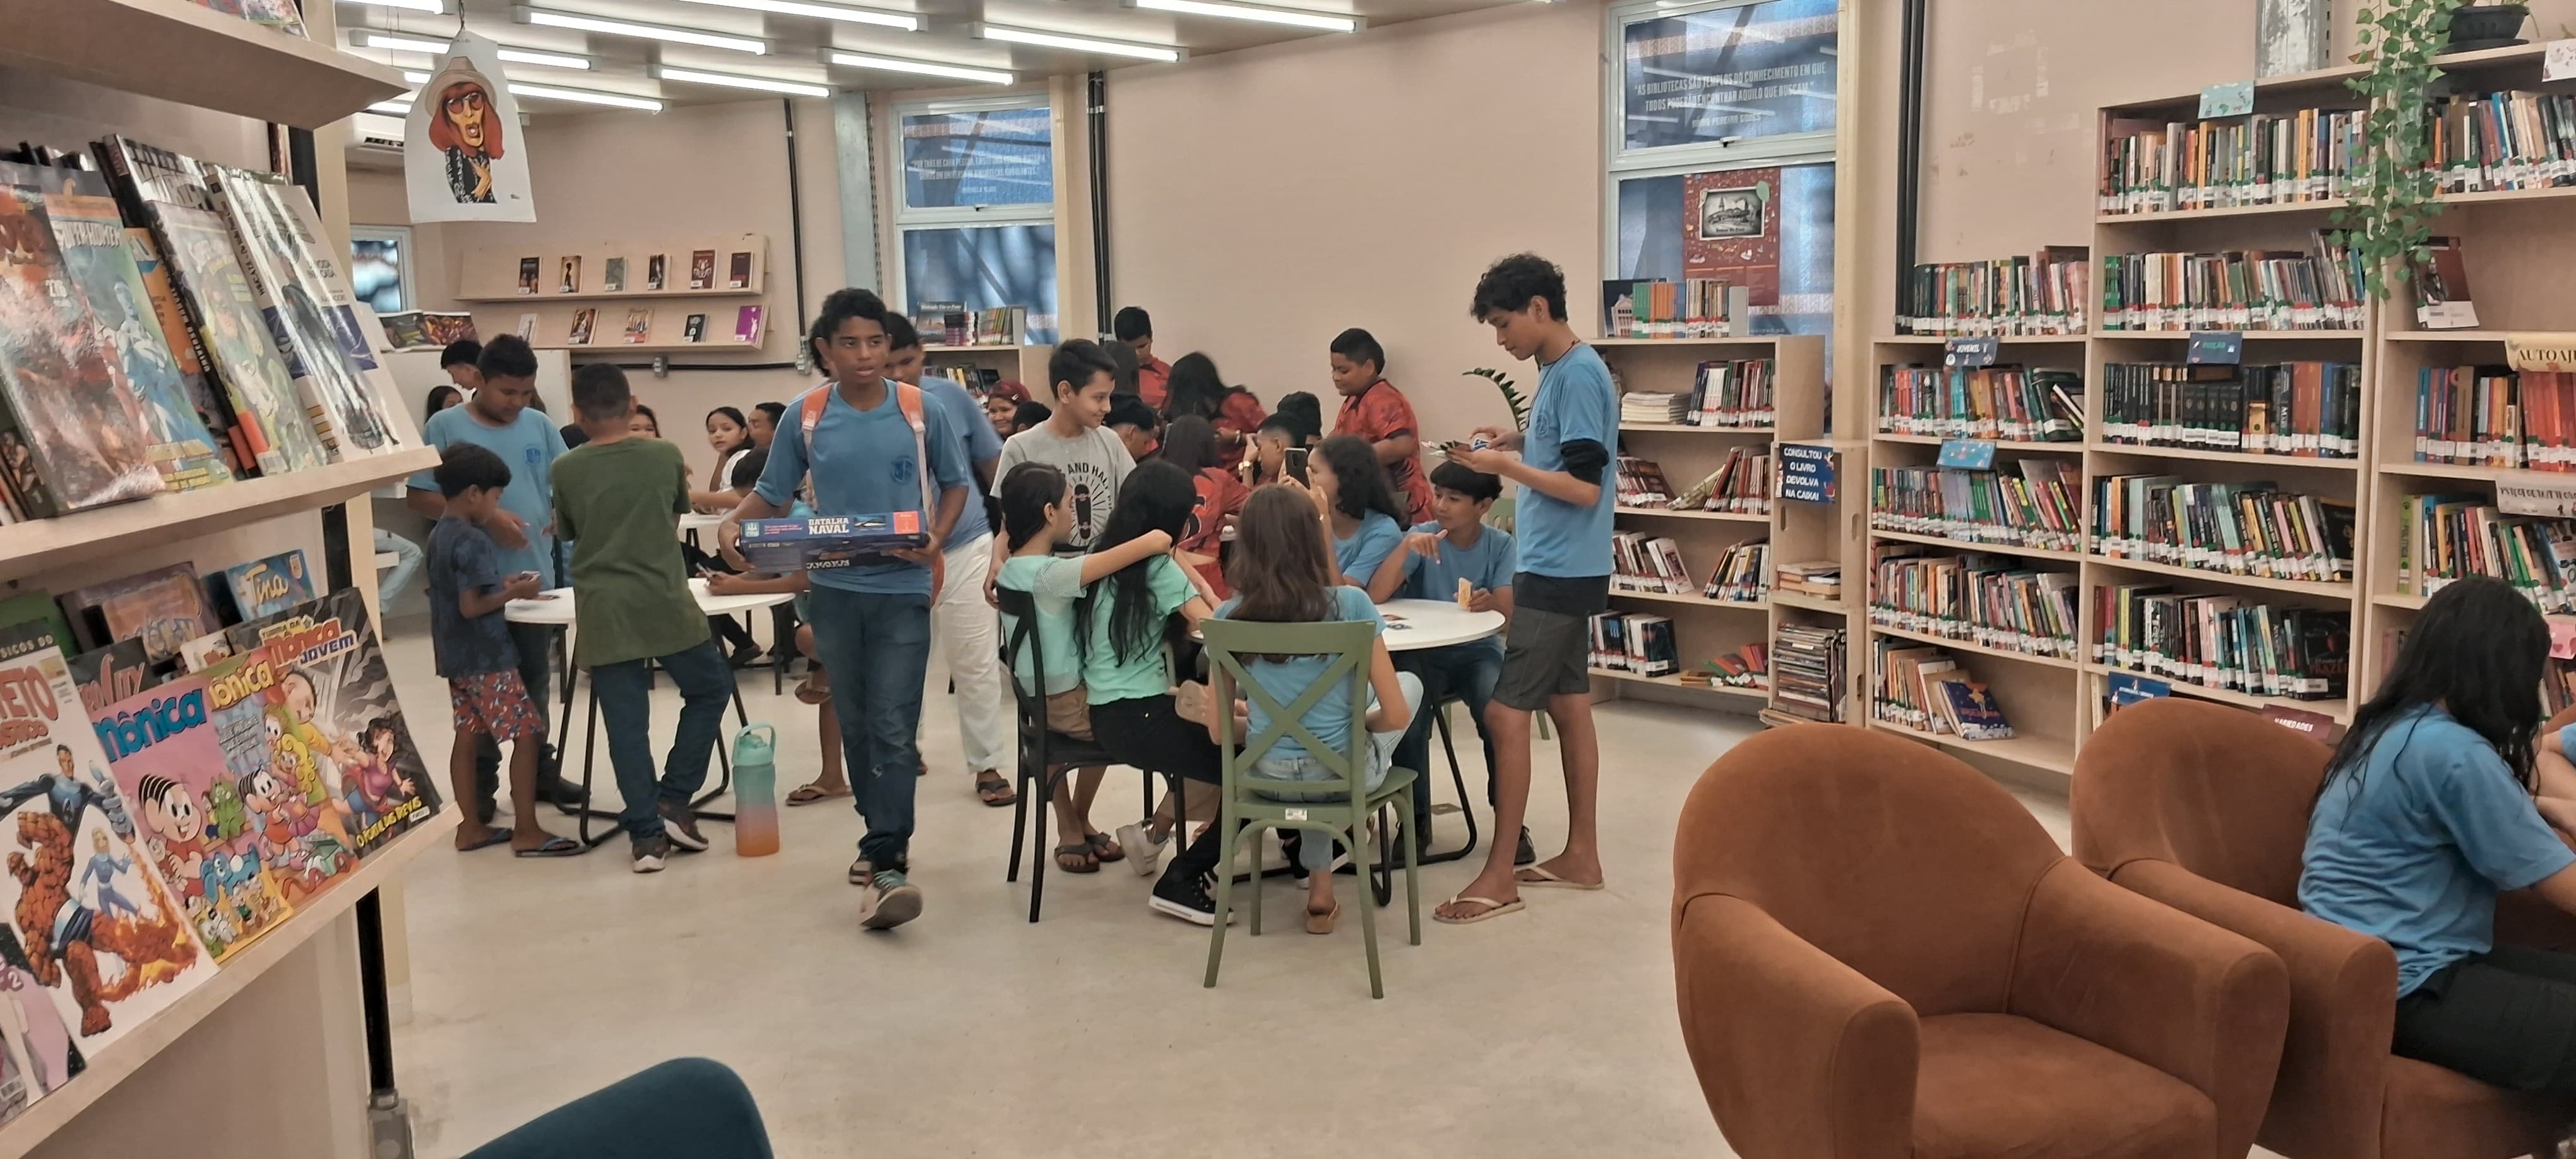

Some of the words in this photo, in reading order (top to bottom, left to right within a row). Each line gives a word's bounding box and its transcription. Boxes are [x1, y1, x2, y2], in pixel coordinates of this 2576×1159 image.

[1647, 79, 1688, 95] BIBLIOTECAS
[1744, 65, 1798, 83] CONHECIMENTO
[1800, 64, 1810, 76] EM
[1811, 61, 1826, 75] QUE
[1645, 98, 1666, 111] TODOS
[1738, 87, 1763, 102] AQUILO
[1764, 85, 1778, 99] QUE
[2518, 349, 2576, 364] AUTOAJ
[1784, 447, 1822, 460] CONSULTOU
[1068, 462, 1089, 474] AND
[1790, 461, 1796, 470] O
[1796, 462, 1816, 473] LIVRO
[1786, 475, 1819, 487] DEVOLVA
[1786, 489, 1796, 498] NA
[808, 518, 849, 526] BATALHA
[809, 524, 849, 535] NAVAL
[245, 563, 289, 605] Tina
[299, 634, 354, 664] JOVEM
